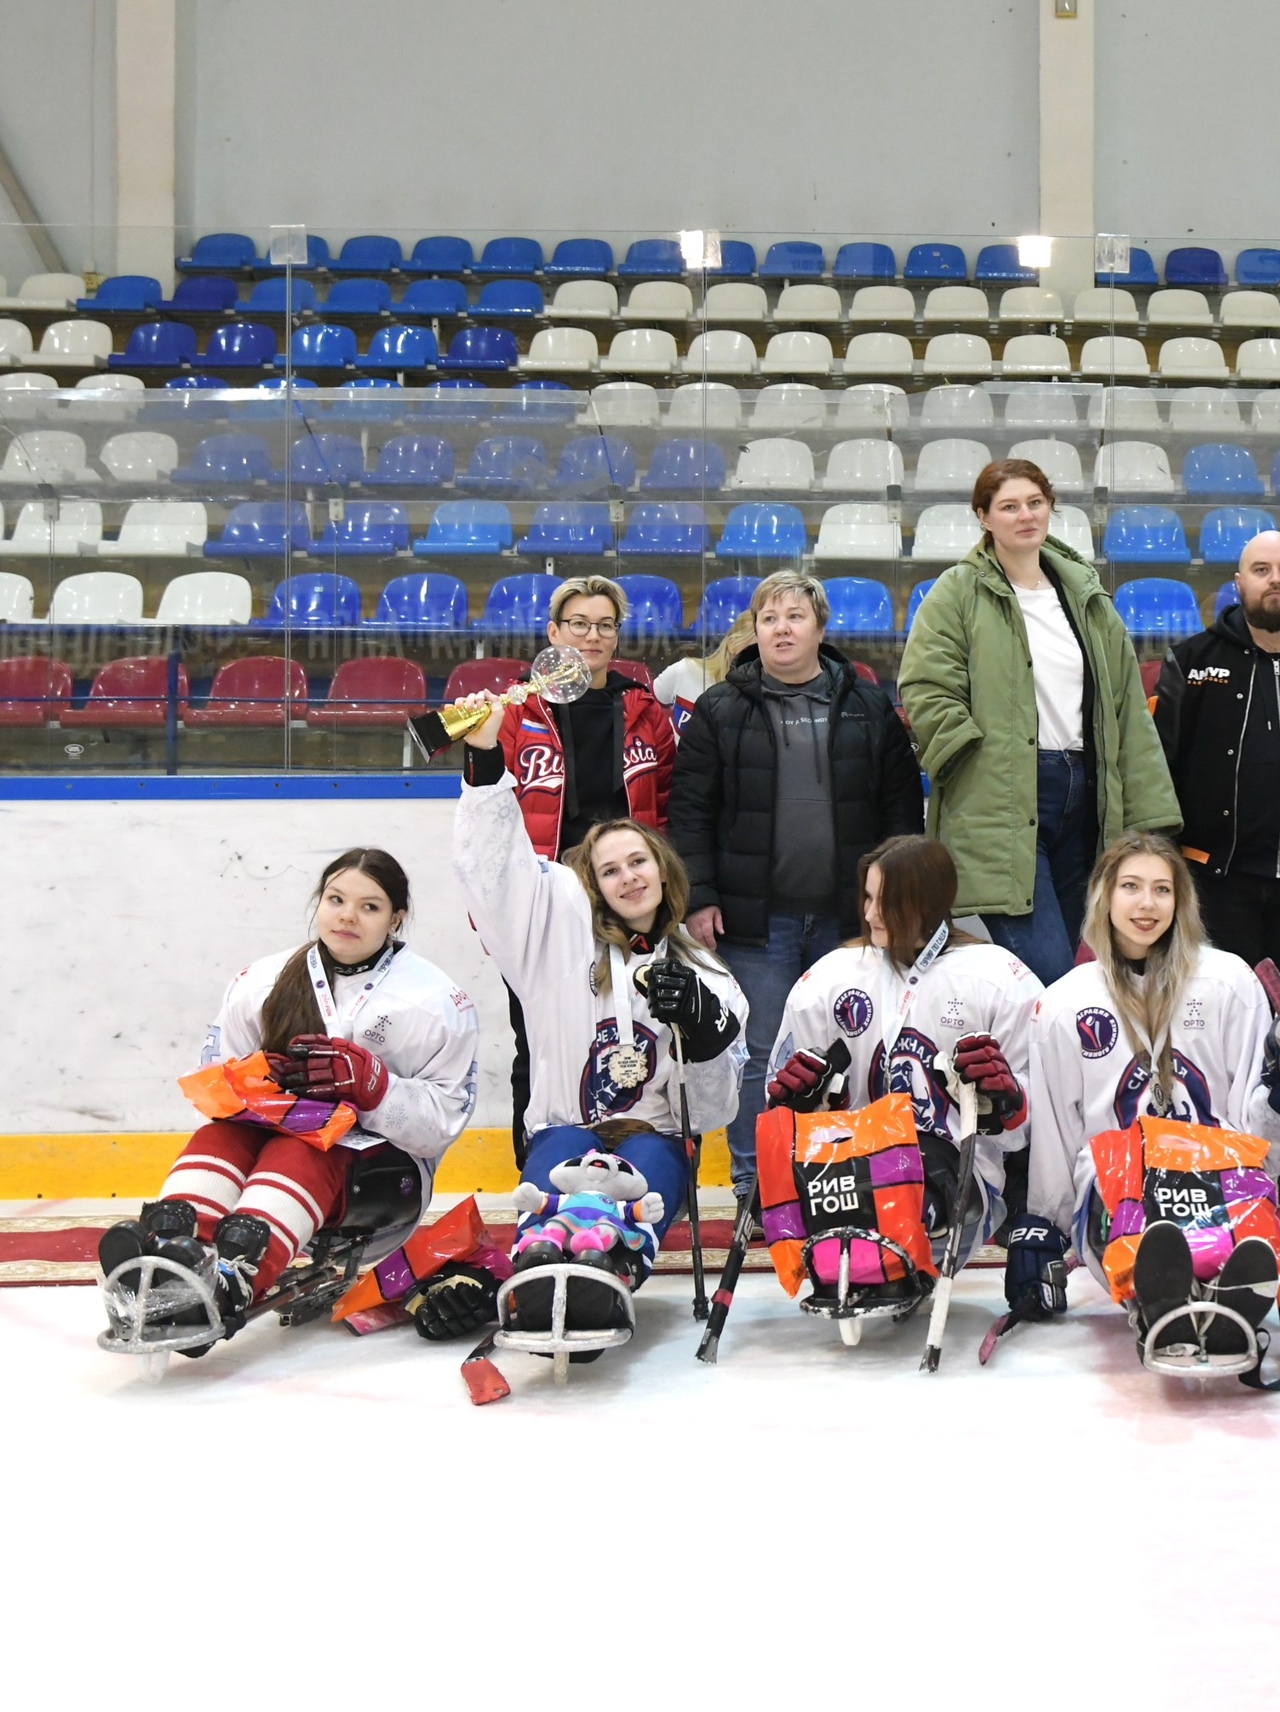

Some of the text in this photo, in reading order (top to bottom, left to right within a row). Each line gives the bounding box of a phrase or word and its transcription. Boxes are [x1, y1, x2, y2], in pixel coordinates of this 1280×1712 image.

[808, 1176, 856, 1197] РИВ
[1157, 1187, 1208, 1203] РИВ
[810, 1192, 859, 1216] ГОШ
[1160, 1201, 1211, 1218] ГОШ
